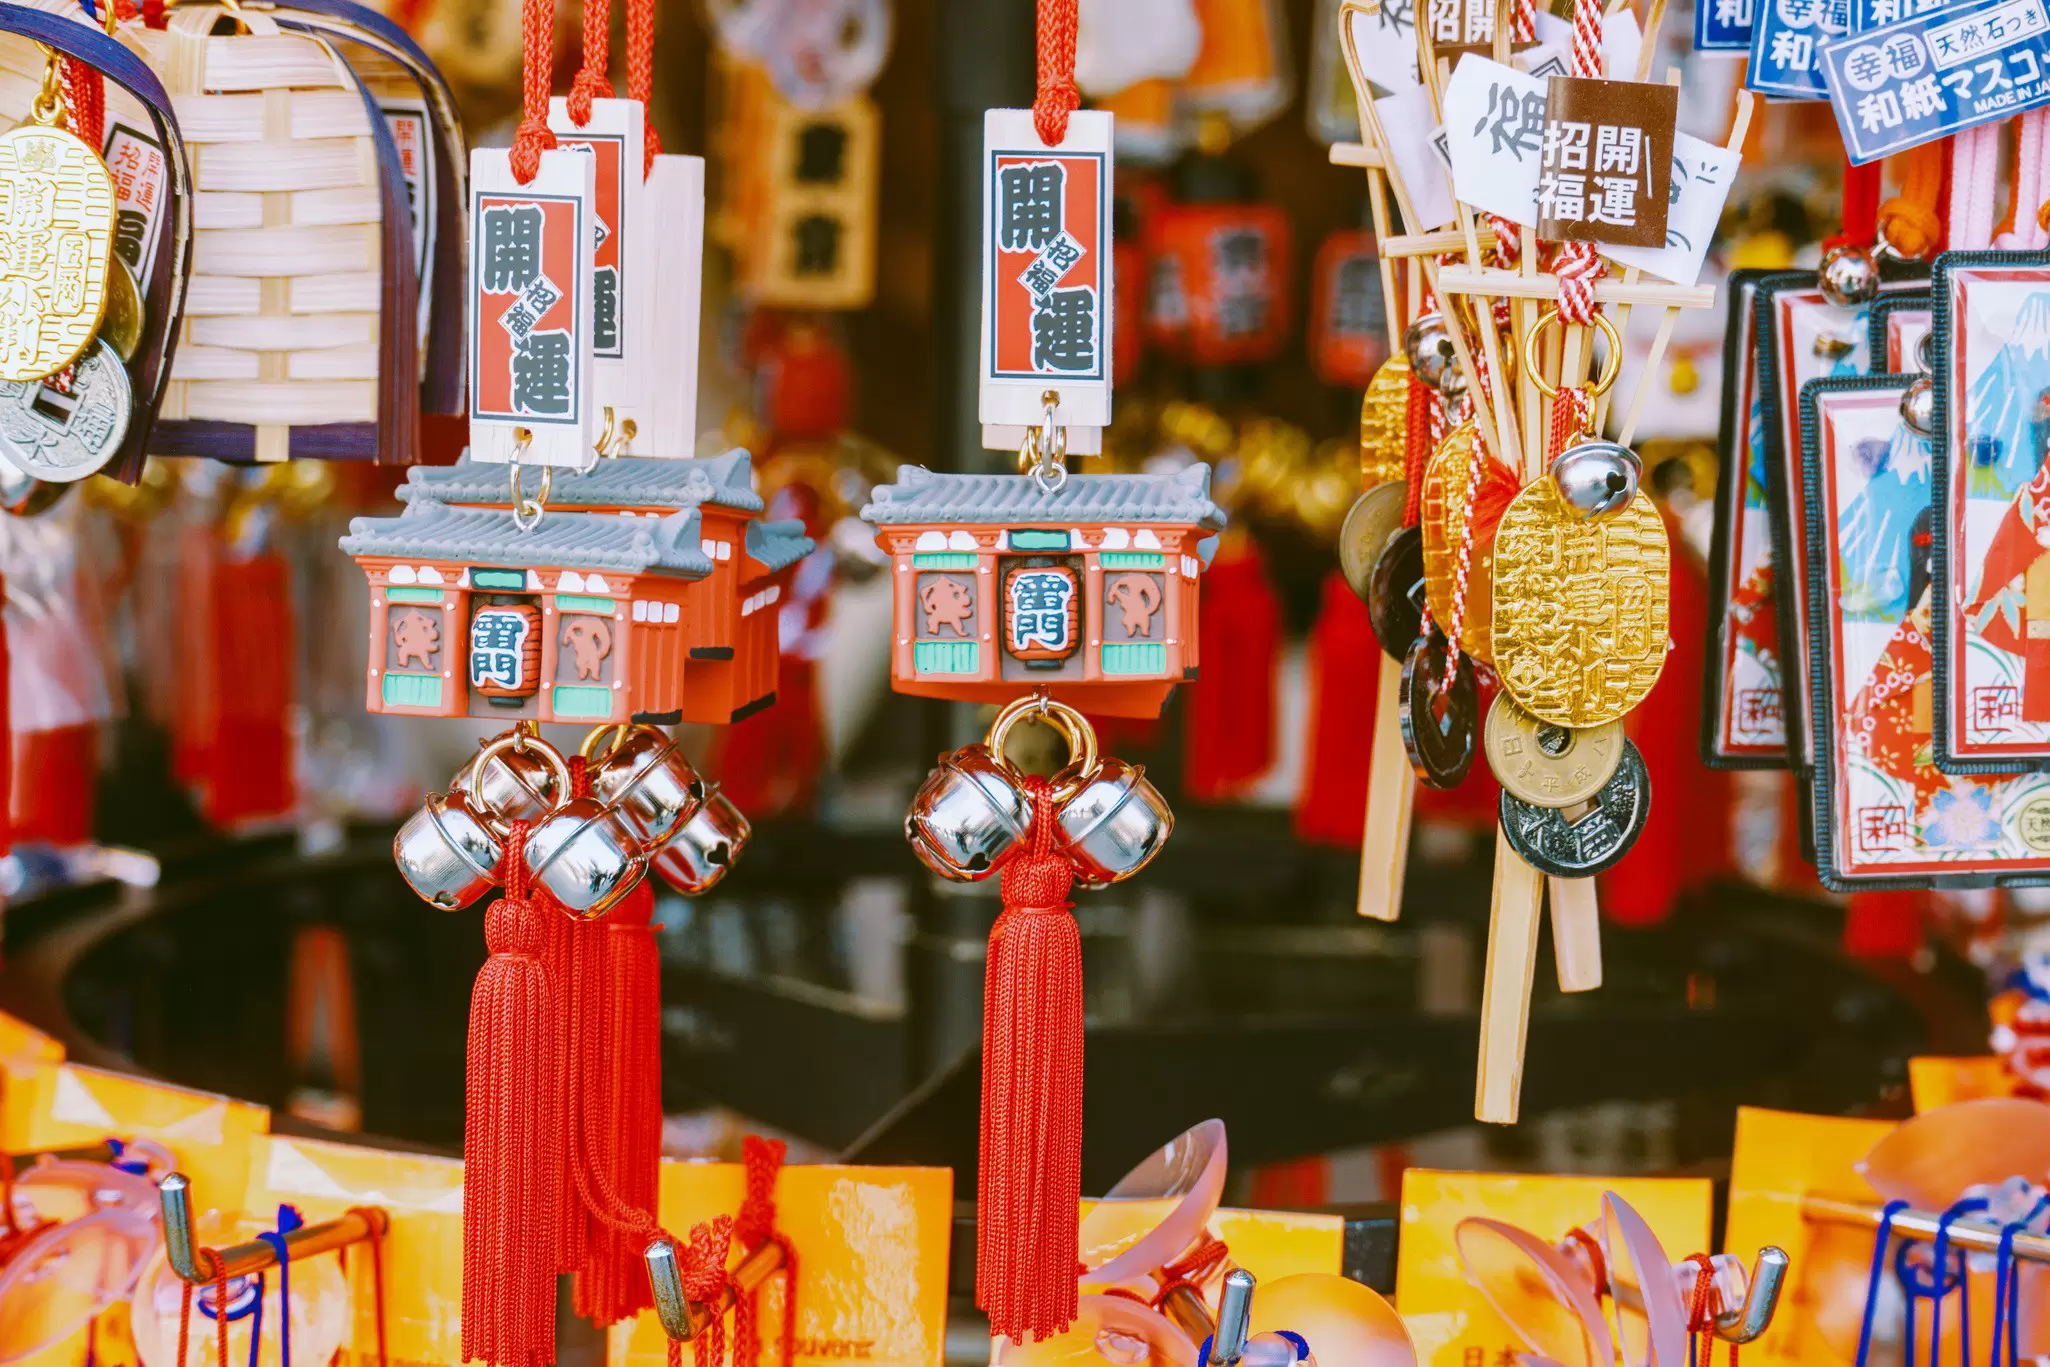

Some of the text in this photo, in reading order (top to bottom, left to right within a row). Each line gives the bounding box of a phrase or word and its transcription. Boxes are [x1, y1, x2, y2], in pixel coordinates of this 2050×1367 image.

[1935, 7, 2038, 57] 天然石つき
[1851, 39, 1921, 84] 幸福
[1973, 77, 2050, 115] MADE IN JA
[1539, 119, 1592, 222] 招福
[1588, 124, 1642, 227] 開運
[1025, 237, 1079, 294] 招福
[506, 280, 556, 341] 招福
